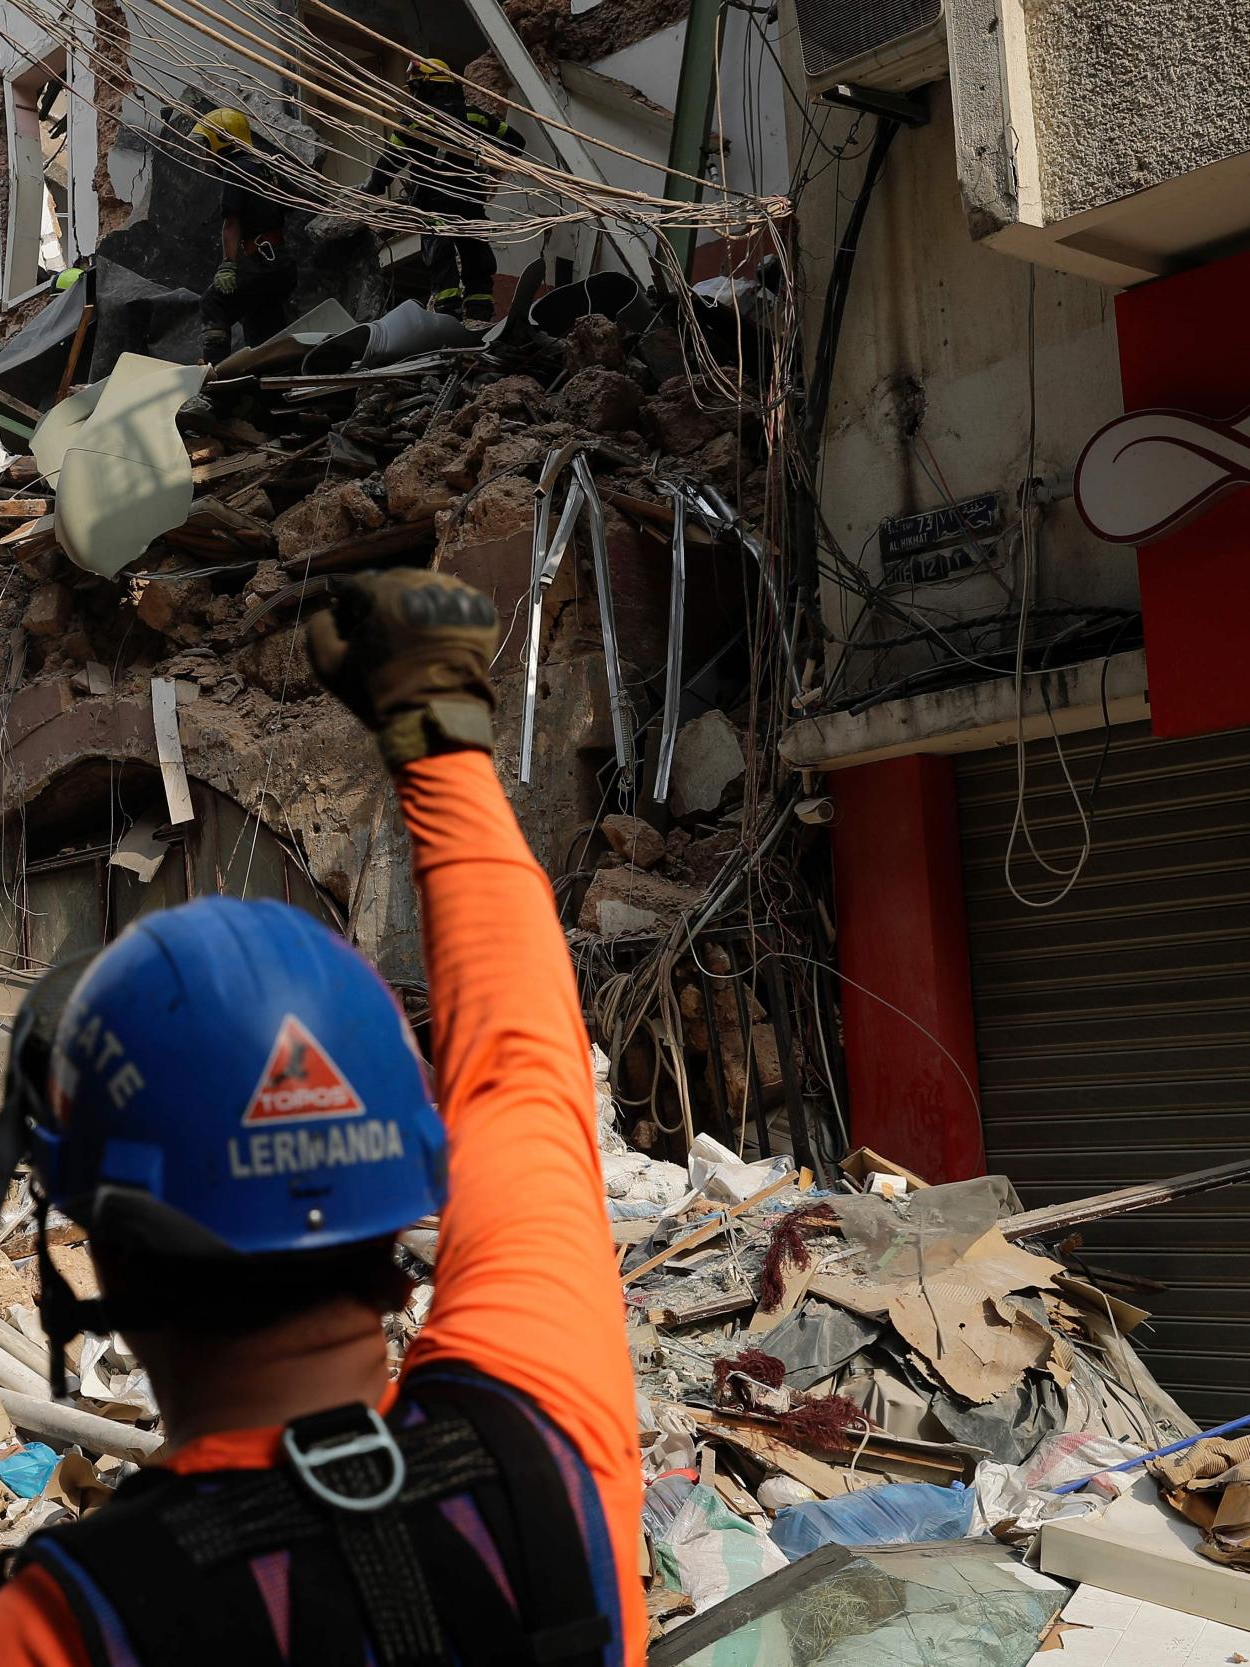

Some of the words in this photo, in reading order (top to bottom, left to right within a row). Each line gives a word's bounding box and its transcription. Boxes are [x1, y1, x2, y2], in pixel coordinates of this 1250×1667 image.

[917, 515, 933, 532] 73
[889, 541, 900, 552] AL
[901, 532, 928, 548] HIKMAT
[919, 559, 938, 579] 12
[260, 1086, 349, 1112] TOPOS
[227, 1119, 405, 1179] LERMANDA
